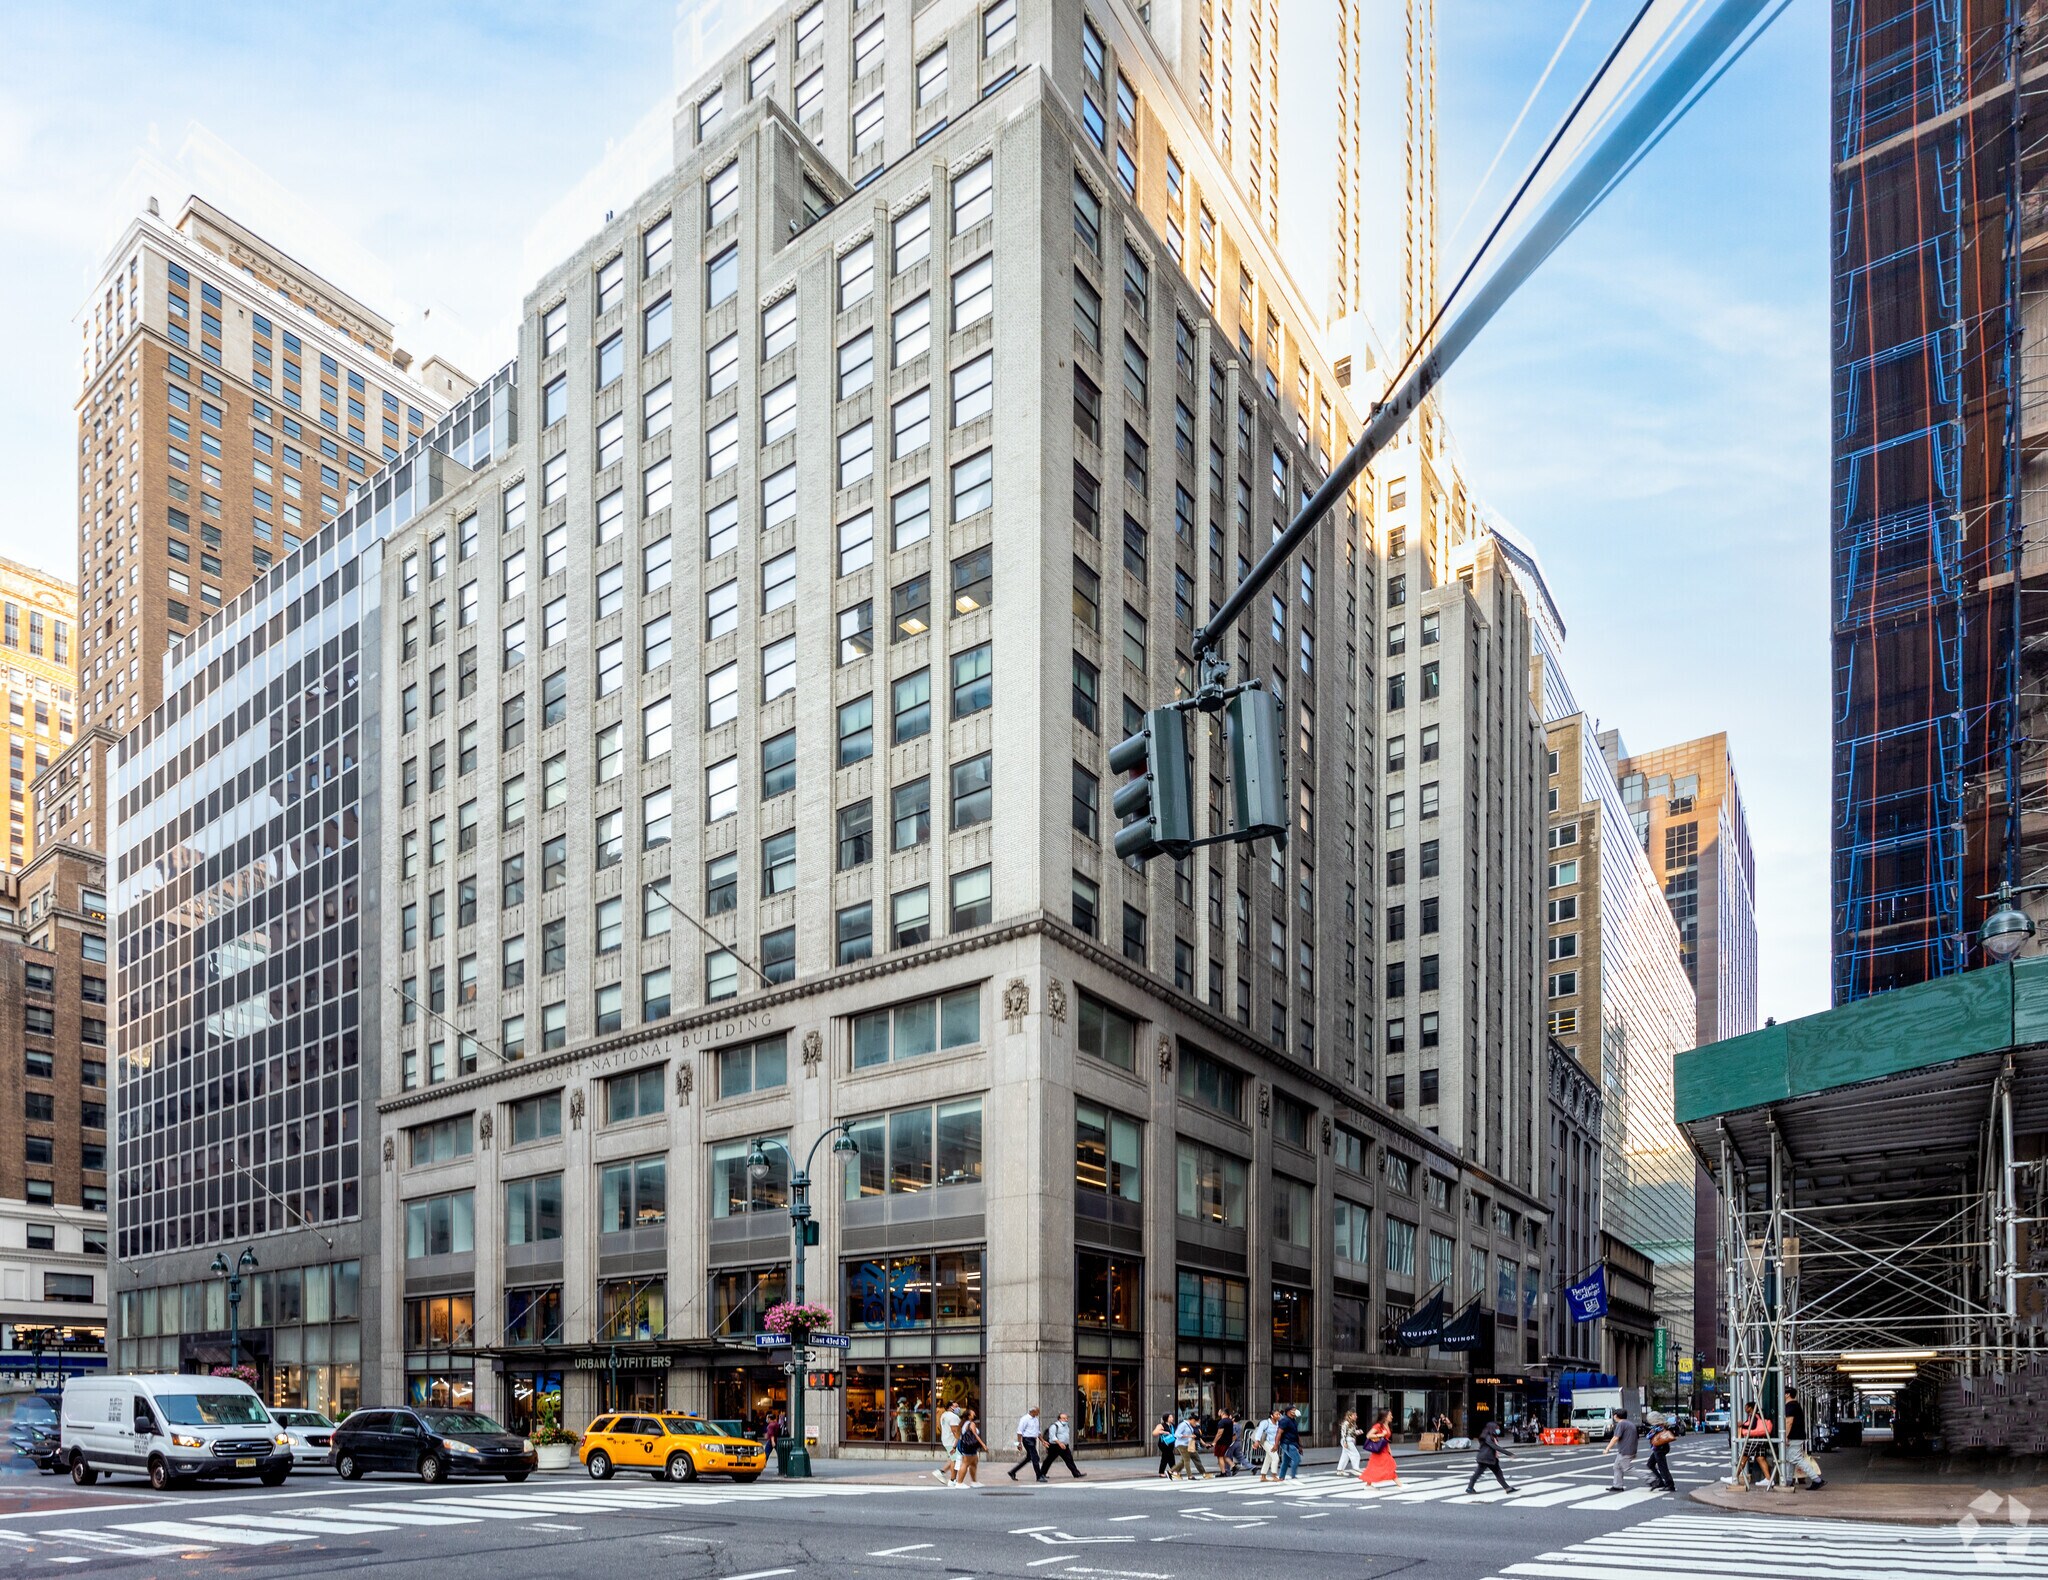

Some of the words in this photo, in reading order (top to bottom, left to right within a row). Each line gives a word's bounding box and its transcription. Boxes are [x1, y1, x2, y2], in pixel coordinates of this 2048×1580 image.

[682, 1013, 772, 1048] BUILDING
[1402, 1328, 1438, 1338] EQUINOX
[761, 1336, 775, 1345] Fifth
[775, 1336, 786, 1344] Ave
[811, 1335, 825, 1344] East
[825, 1337, 840, 1345] 43rd
[840, 1338, 847, 1346] St
[574, 1358, 606, 1369] URBAN
